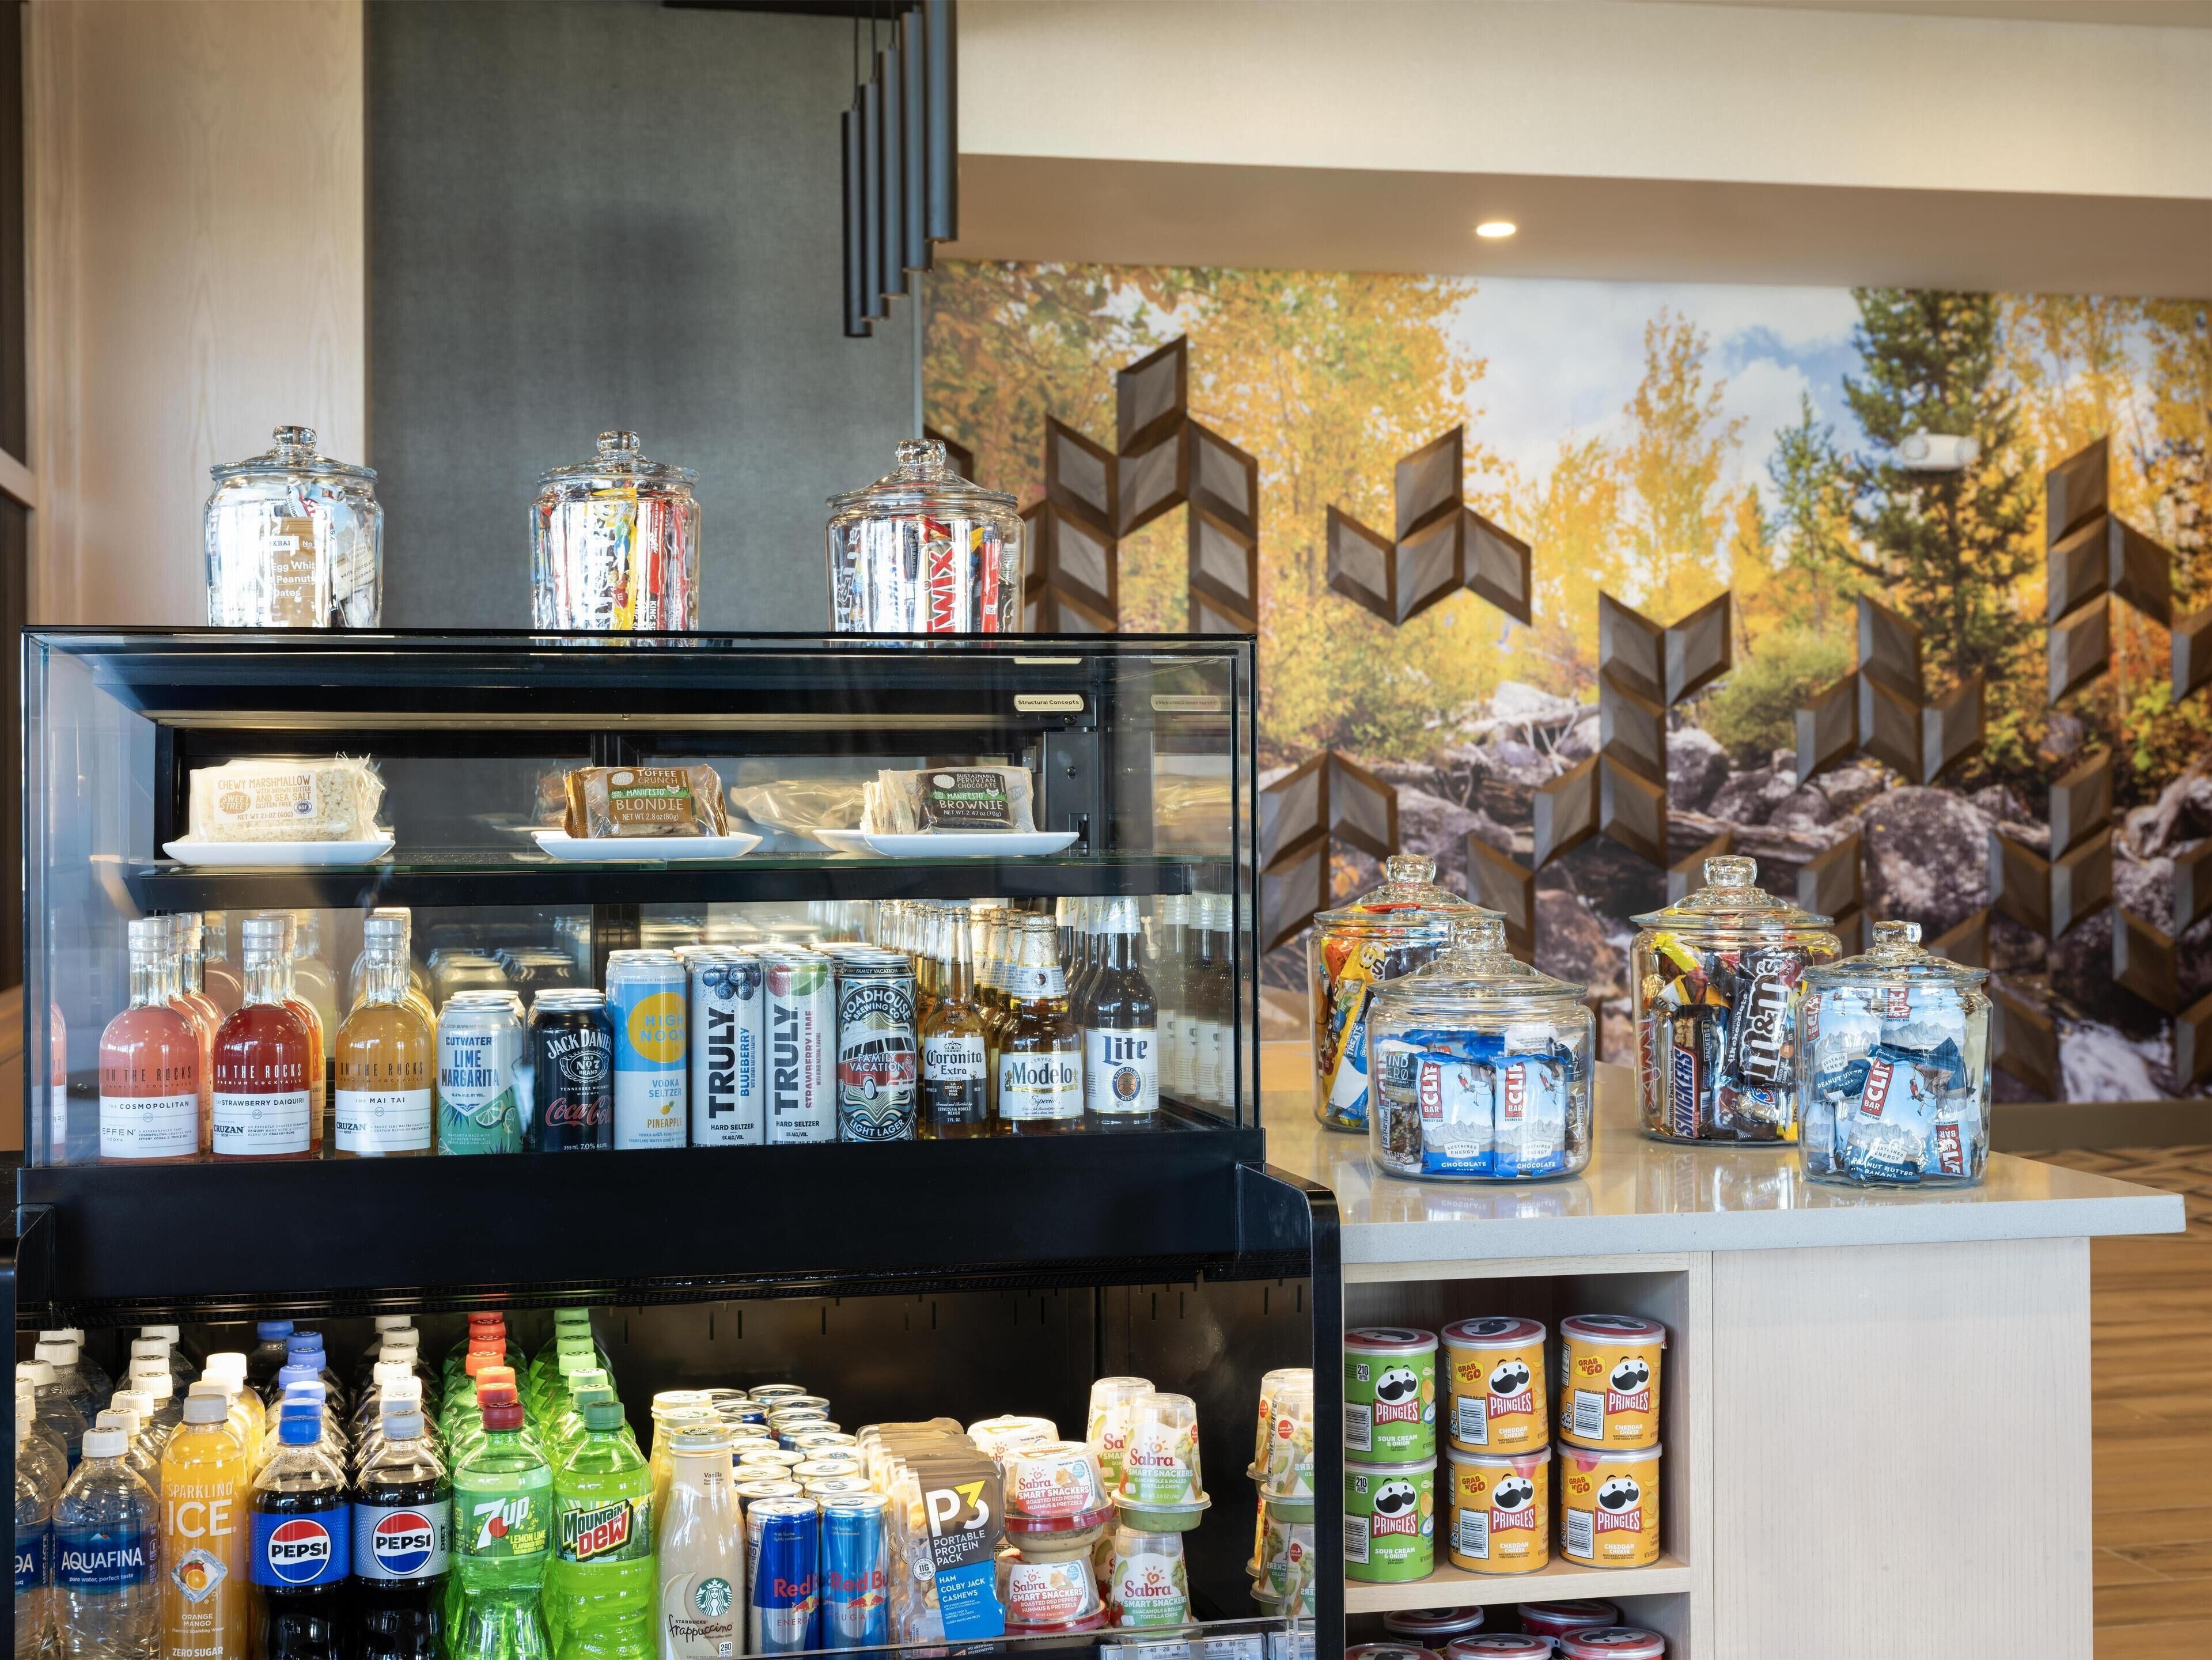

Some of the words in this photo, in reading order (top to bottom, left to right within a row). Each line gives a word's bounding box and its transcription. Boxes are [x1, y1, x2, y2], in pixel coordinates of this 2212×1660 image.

[218, 780, 245, 790] CHEWY
[249, 775, 310, 788] MARSHMALLOW
[275, 794, 289, 802] SEA
[293, 793, 310, 801] SALT
[616, 798, 684, 810] BLONDIE
[940, 801, 1003, 810] BROWNIE
[842, 991, 911, 1022] ROADHOUSE
[853, 1003, 888, 1021] BREWING
[446, 1037, 492, 1046] CUTWATER
[546, 1034, 579, 1059] JACK
[857, 1052, 896, 1063] FAMILY
[1102, 1035, 1148, 1066] Lite
[454, 1049, 481, 1068] LIME
[709, 1007, 734, 1119] TRULY
[740, 1028, 749, 1097] BLUEBERRY
[774, 1004, 799, 1116] TRULY
[926, 1049, 983, 1068] Coronita
[106, 1069, 115, 1082] ON
[124, 1069, 146, 1082] THE
[157, 1066, 192, 1081] ROCKS
[218, 1064, 226, 1078] ON
[234, 1066, 254, 1078] THE
[266, 1063, 301, 1078] ROCKS
[849, 1062, 905, 1072] VACATION
[941, 1065, 967, 1075] Extra
[1012, 1062, 1072, 1085] Modelo
[441, 1068, 499, 1087] MARGARITA
[652, 1079, 679, 1087] VODKA
[1423, 1064, 1438, 1105] CLIF
[649, 1089, 681, 1097] SELTZER
[1674, 1048, 1693, 1137] SNICKERS
[120, 1101, 189, 1109] COSMOPOLITAN
[1864, 1100, 1880, 1110] BAR
[214, 1125, 243, 1134] CRUZAN
[336, 1122, 366, 1131] CRUZAN
[647, 1117, 681, 1128] PINEAPPLE
[850, 1118, 874, 1136] LIGHT
[877, 1118, 904, 1136] LAGER
[1885, 1165, 1913, 1176] BUTTER
[1458, 1363, 1476, 1373] GRAB
[1490, 1393, 1531, 1416] PRINGLES
[1609, 1392, 1648, 1411] PRINGLES
[1376, 1401, 1418, 1423] PRINGLES
[1130, 1448, 1173, 1466] Sabra
[168, 1483, 233, 1498] SPARKLING
[1019, 1478, 1051, 1490] Sabra
[1018, 1490, 1046, 1500] SMART
[1048, 1485, 1089, 1496] SNACKERS
[925, 1480, 990, 1538] P3
[169, 1499, 232, 1538] ICE
[1374, 1514, 1415, 1535] PRINGLES
[1493, 1509, 1533, 1530] PRINGLES
[1598, 1510, 1639, 1530] PRINGLES
[376, 1534, 430, 1549] PEPSI
[510, 1533, 533, 1544] LEMON
[535, 1530, 546, 1541] LIME
[934, 1530, 986, 1548] PORTABLE
[271, 1542, 327, 1557] PEPSI
[935, 1541, 979, 1557] PROTEIN
[61, 1547, 143, 1573] AQUAFINA
[937, 1553, 963, 1566] PACK
[919, 1564, 929, 1572] 11G
[774, 1574, 810, 1597] Red
[831, 1571, 868, 1592] Red
[940, 1575, 956, 1583] HAM
[941, 1582, 965, 1593] COLBY
[967, 1578, 986, 1587] JACK
[1013, 1581, 1046, 1592] Sabra
[942, 1590, 978, 1602] CASHEWS
[1125, 1581, 1171, 1597] Sabra
[172, 1647, 193, 1657] ZERO
[194, 1646, 224, 1657] SUGAR
